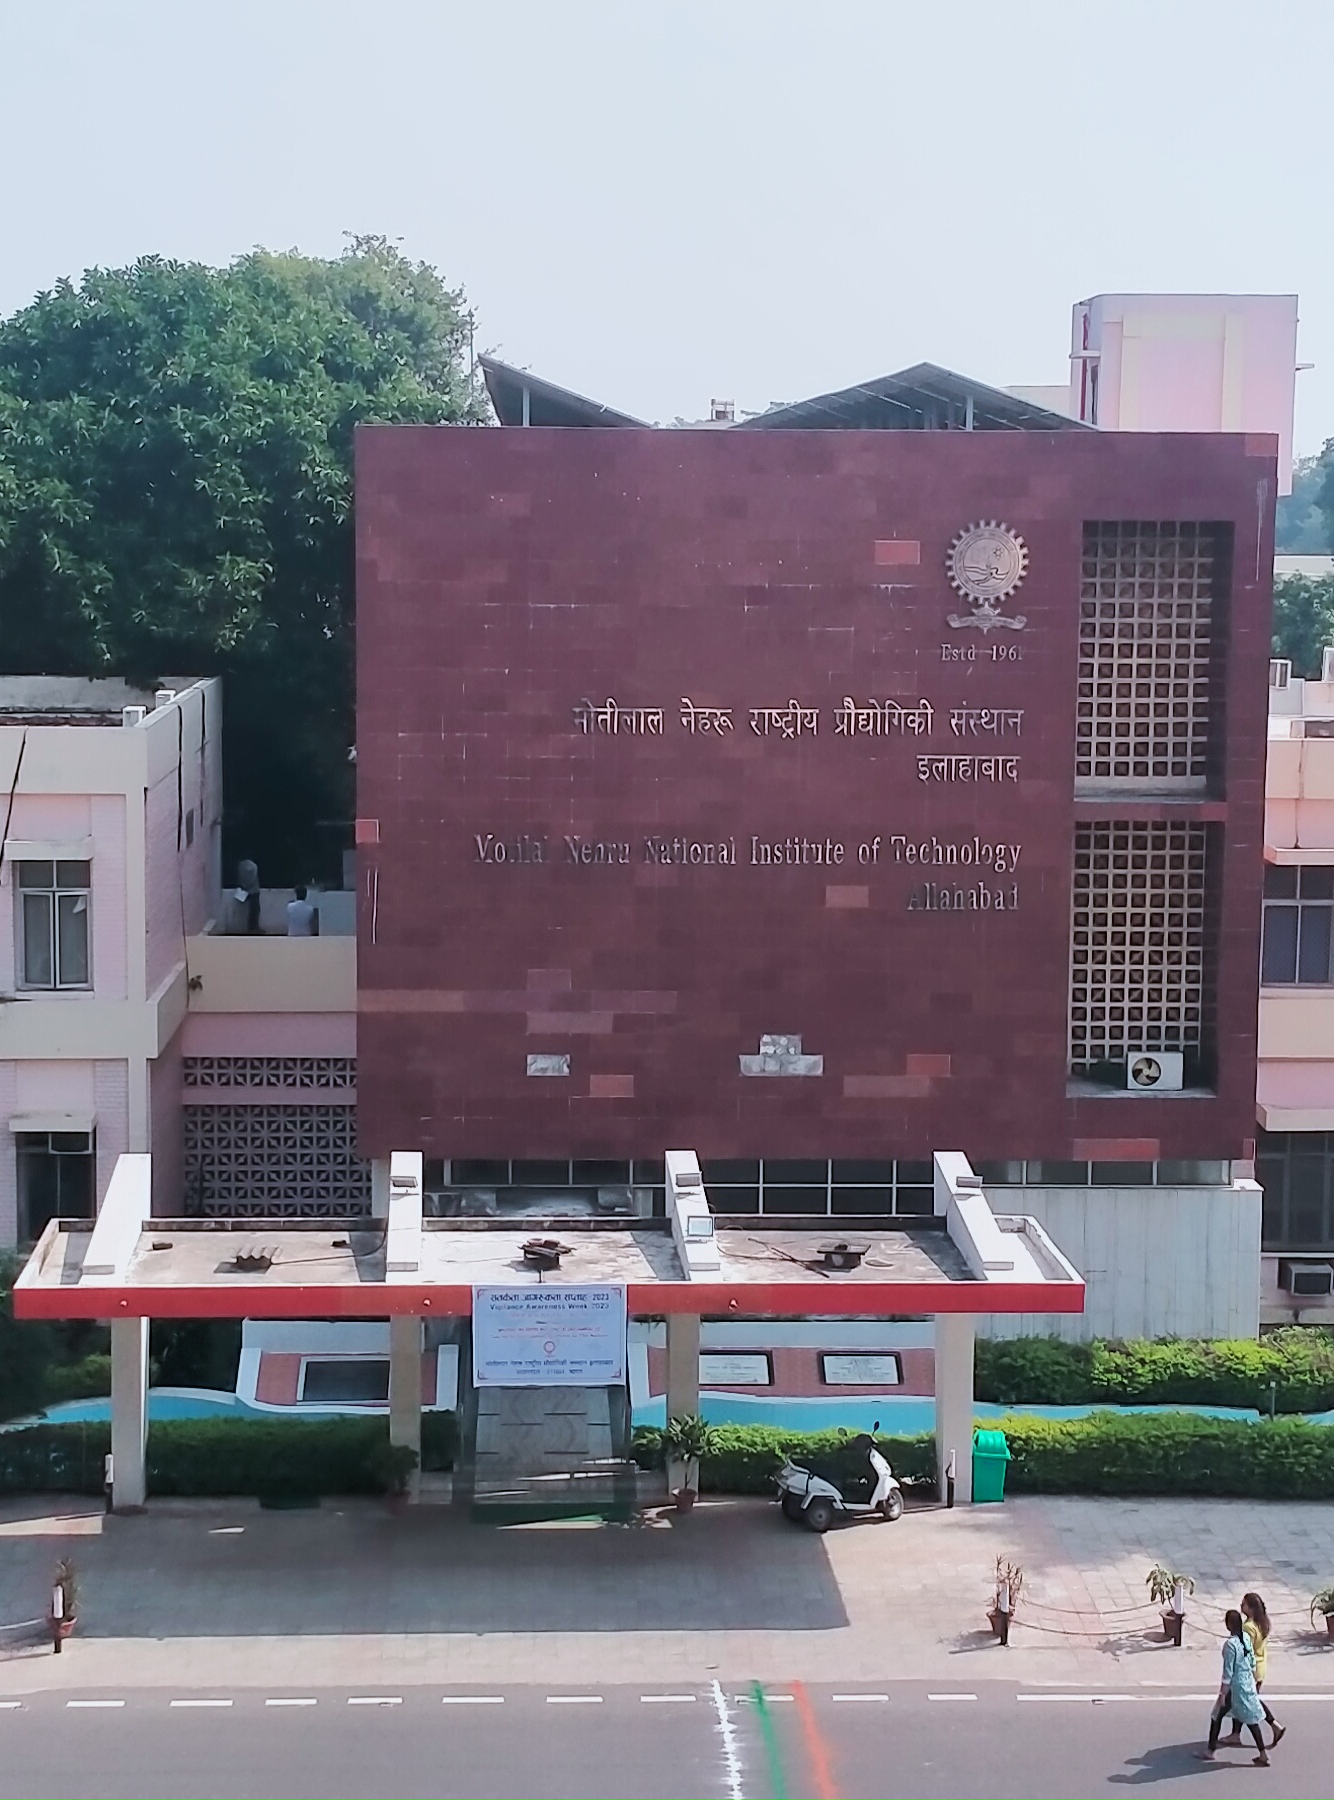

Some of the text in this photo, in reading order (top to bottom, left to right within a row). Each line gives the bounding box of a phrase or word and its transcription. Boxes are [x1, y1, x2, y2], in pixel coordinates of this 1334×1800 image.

[572, 696, 1025, 739] मोतीलाल नेहरू राष्ट्रीय प्रौद्योगिकी संस्थान
[917, 755, 1021, 784] इलाहाबाद
[474, 834, 551, 864] Moila
[643, 835, 738, 865] National
[750, 836, 845, 865] Institute
[858, 836, 881, 865] of
[890, 835, 1022, 873] Technology
[592, 1293, 609, 1301] 2023
